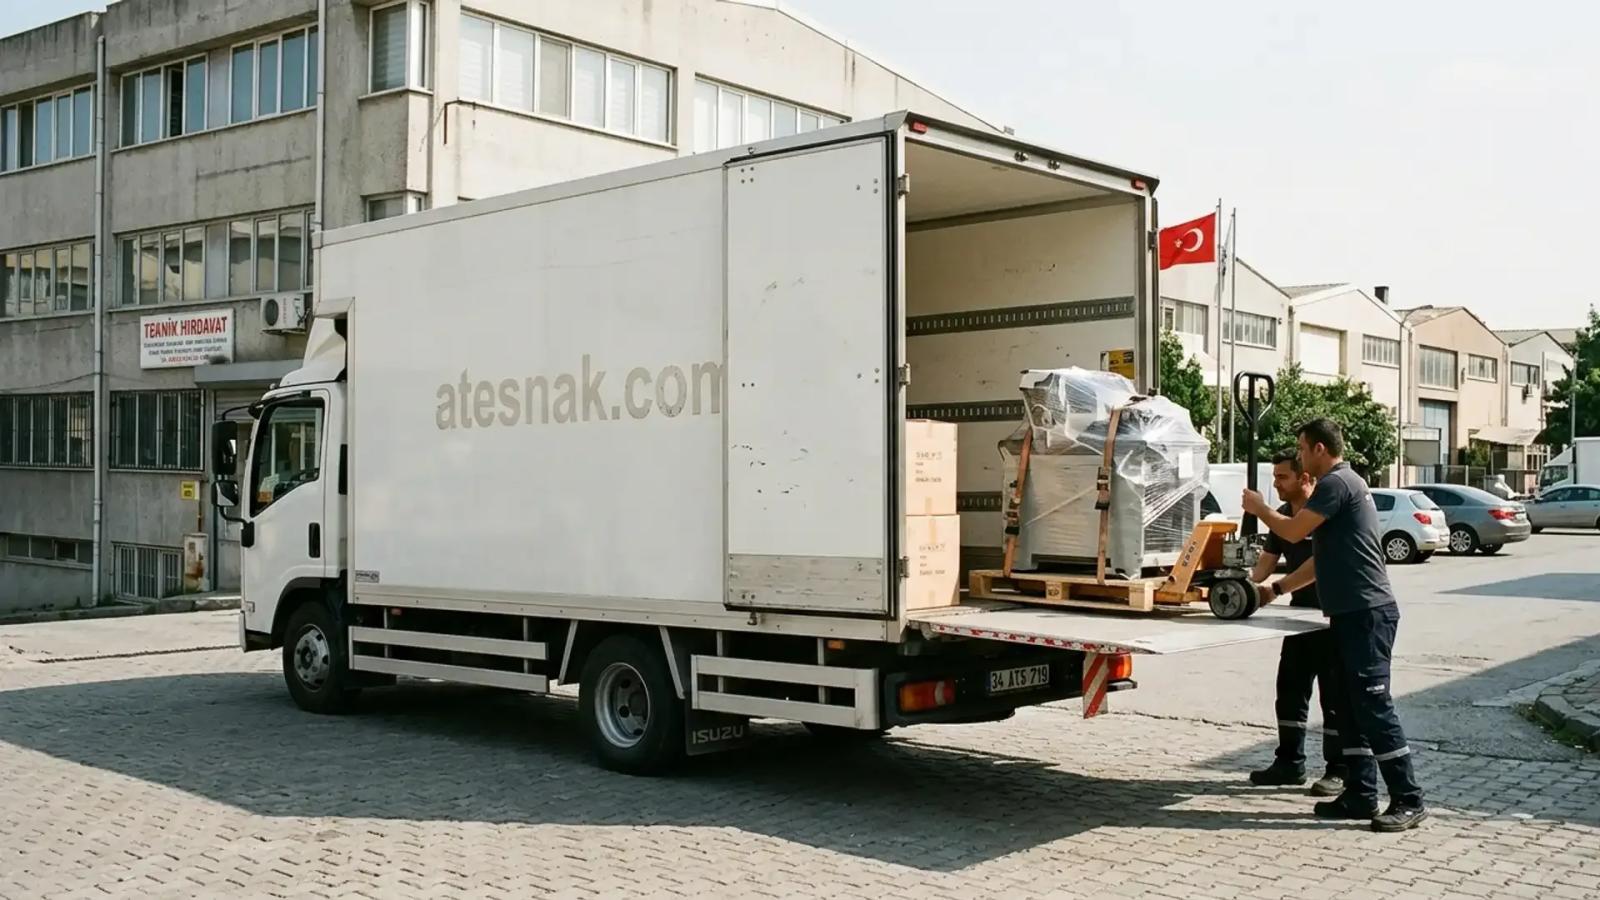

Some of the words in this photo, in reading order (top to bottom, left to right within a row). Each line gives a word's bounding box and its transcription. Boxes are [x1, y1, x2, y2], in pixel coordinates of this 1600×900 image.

[180, 316, 227, 336] HIRDAVAT
[992, 672, 1004, 689] 34
[1008, 669, 1027, 687] ATS
[1030, 666, 1048, 684] 719
[692, 725, 744, 744] ISUZU
